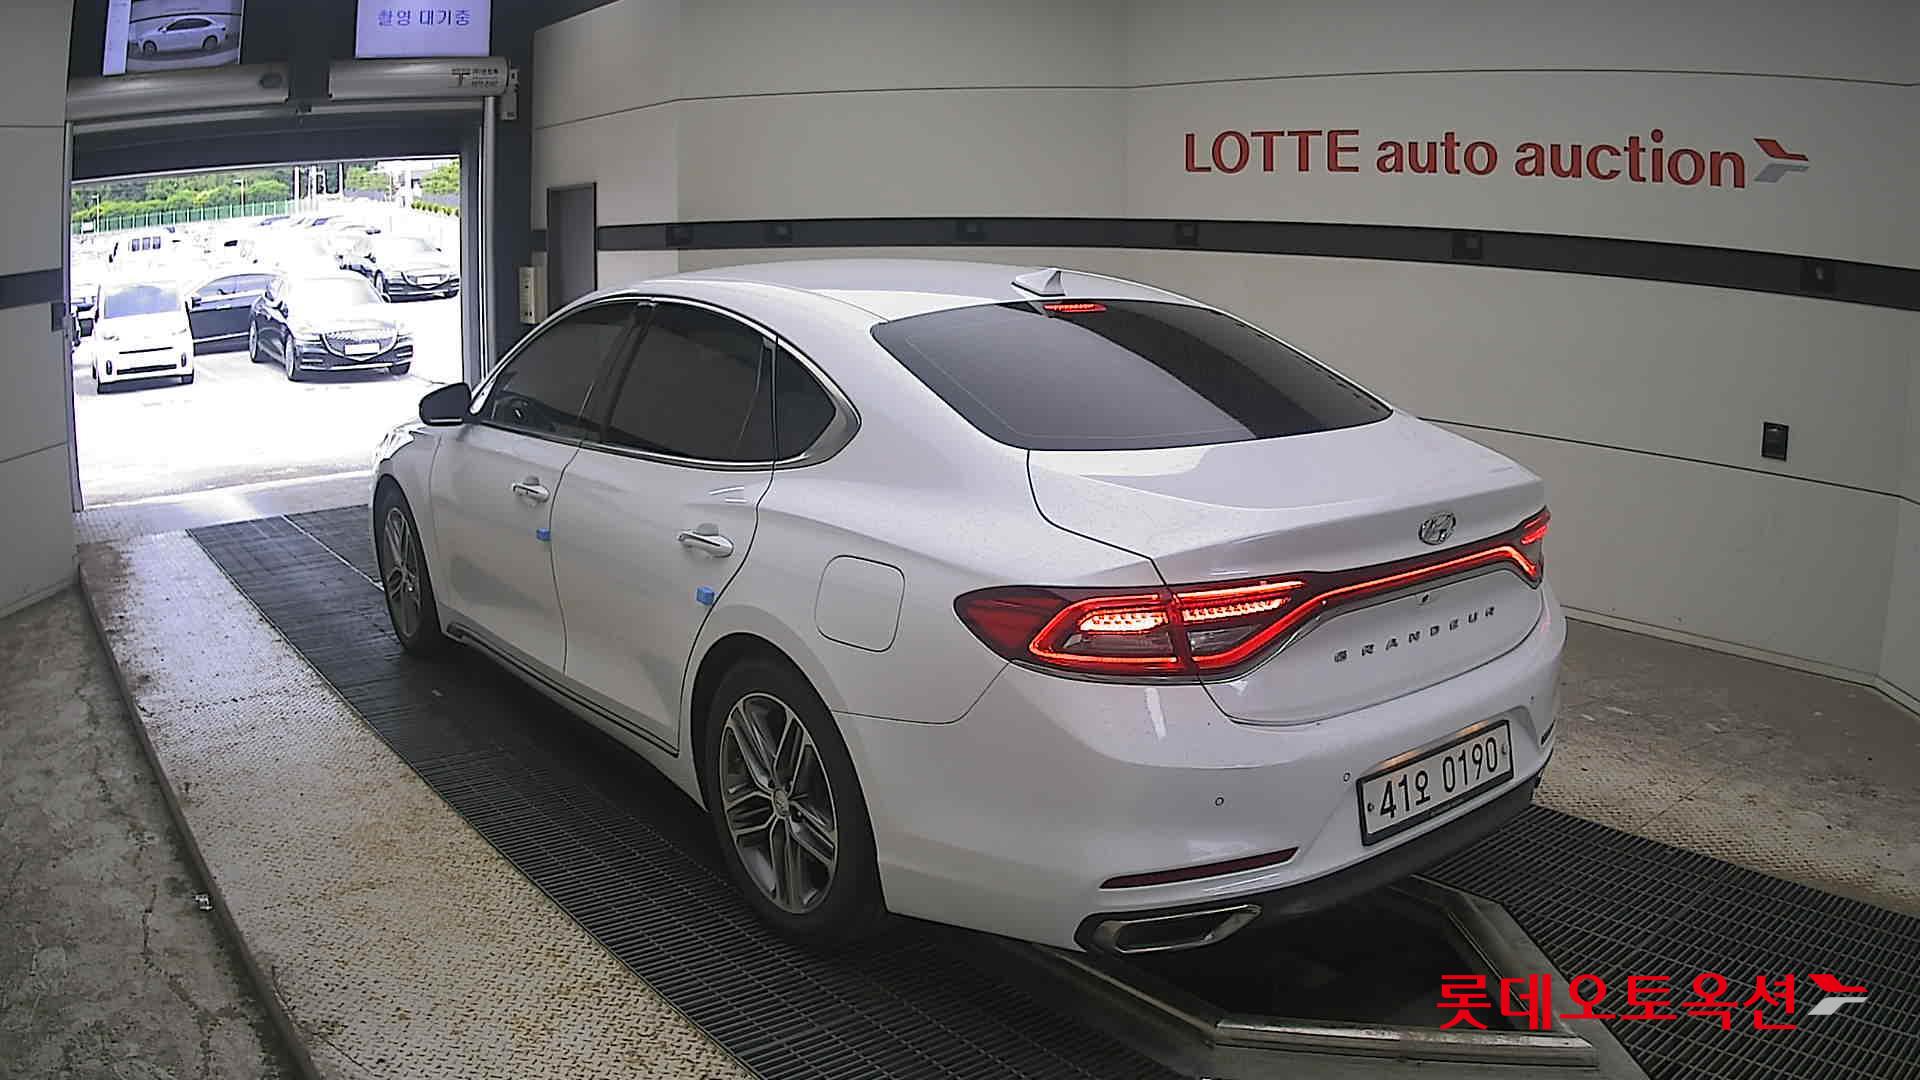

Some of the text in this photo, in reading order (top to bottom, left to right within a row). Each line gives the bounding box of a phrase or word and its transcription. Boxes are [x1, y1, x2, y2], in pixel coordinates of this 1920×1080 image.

[419, 9, 470, 26] 대기중
[1184, 129, 1745, 188] LOTTE auto auction
[1334, 607, 1495, 663] GRANDEUR
[1380, 737, 1498, 818] 41오 0190
